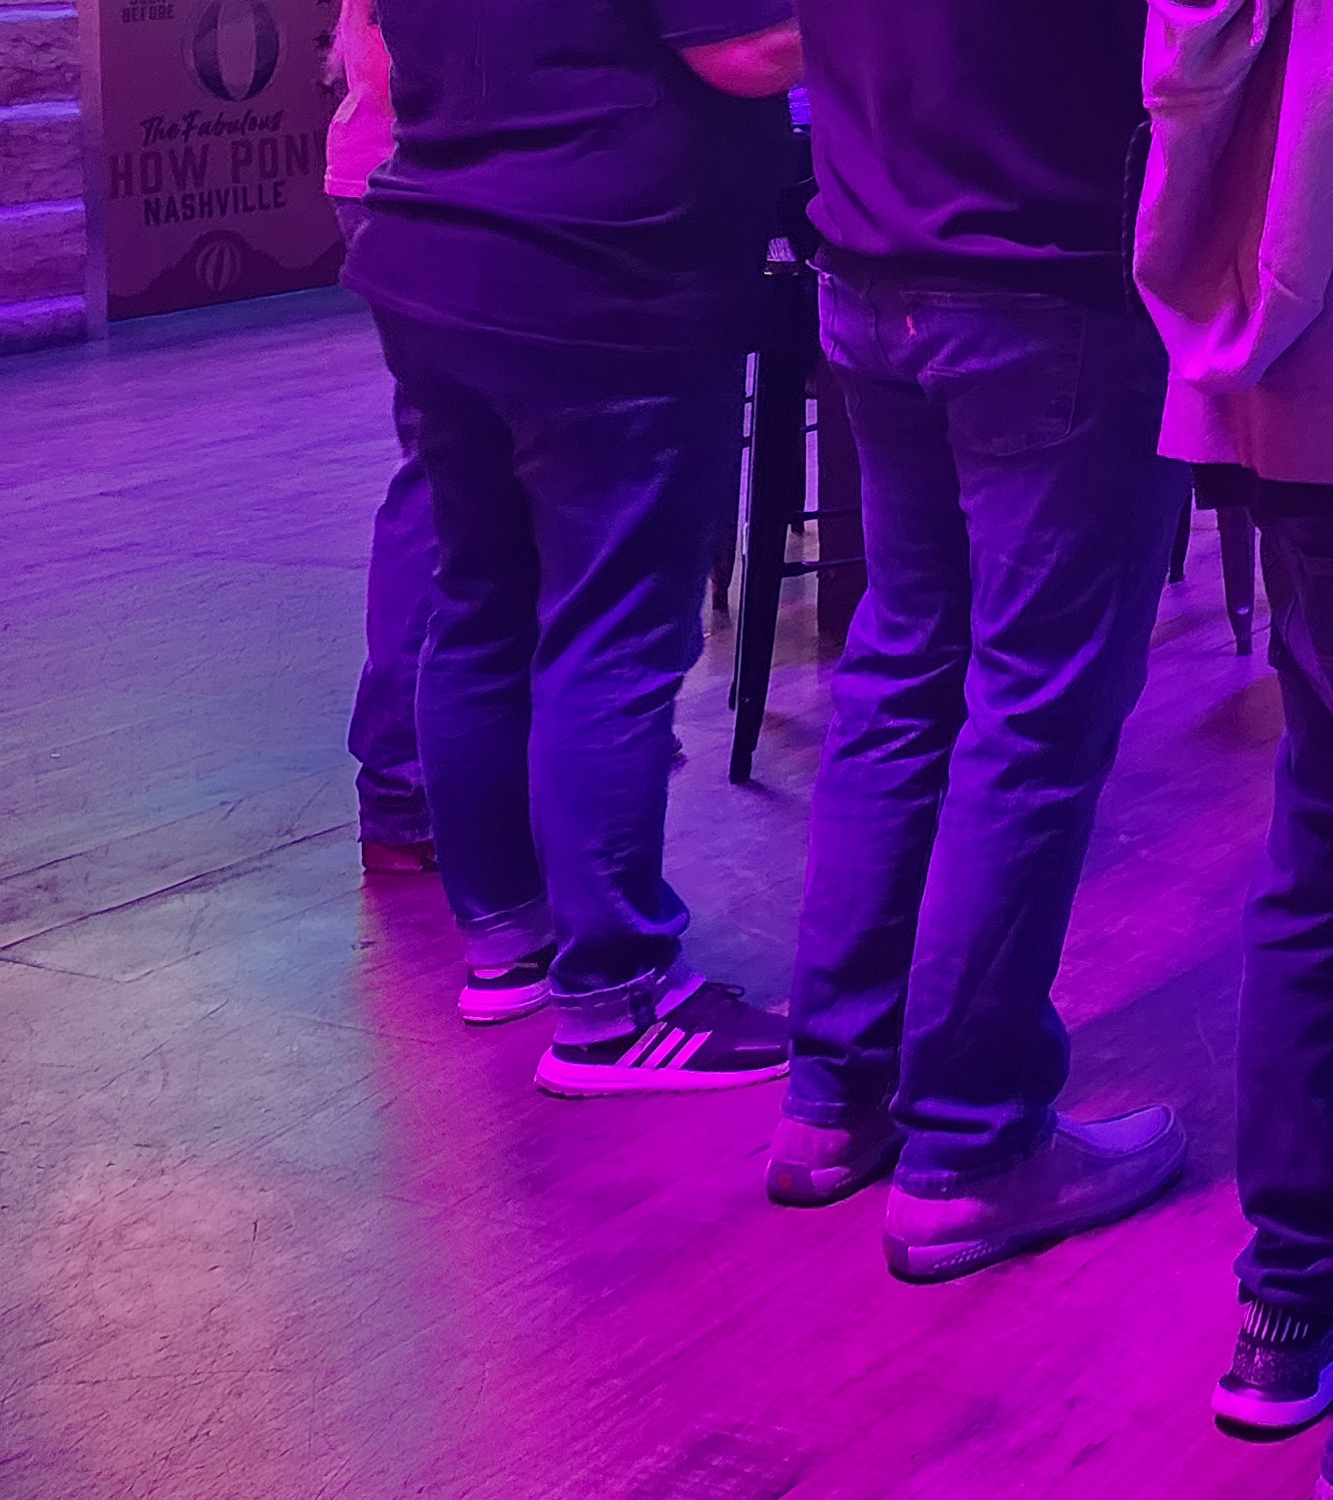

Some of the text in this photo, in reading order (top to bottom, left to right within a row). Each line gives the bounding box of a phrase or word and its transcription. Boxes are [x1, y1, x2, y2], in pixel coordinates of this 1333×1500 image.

[121, 4, 175, 24] BEFORE
[140, 108, 285, 148] The Fabulous
[143, 180, 287, 228] NASHVILLE
